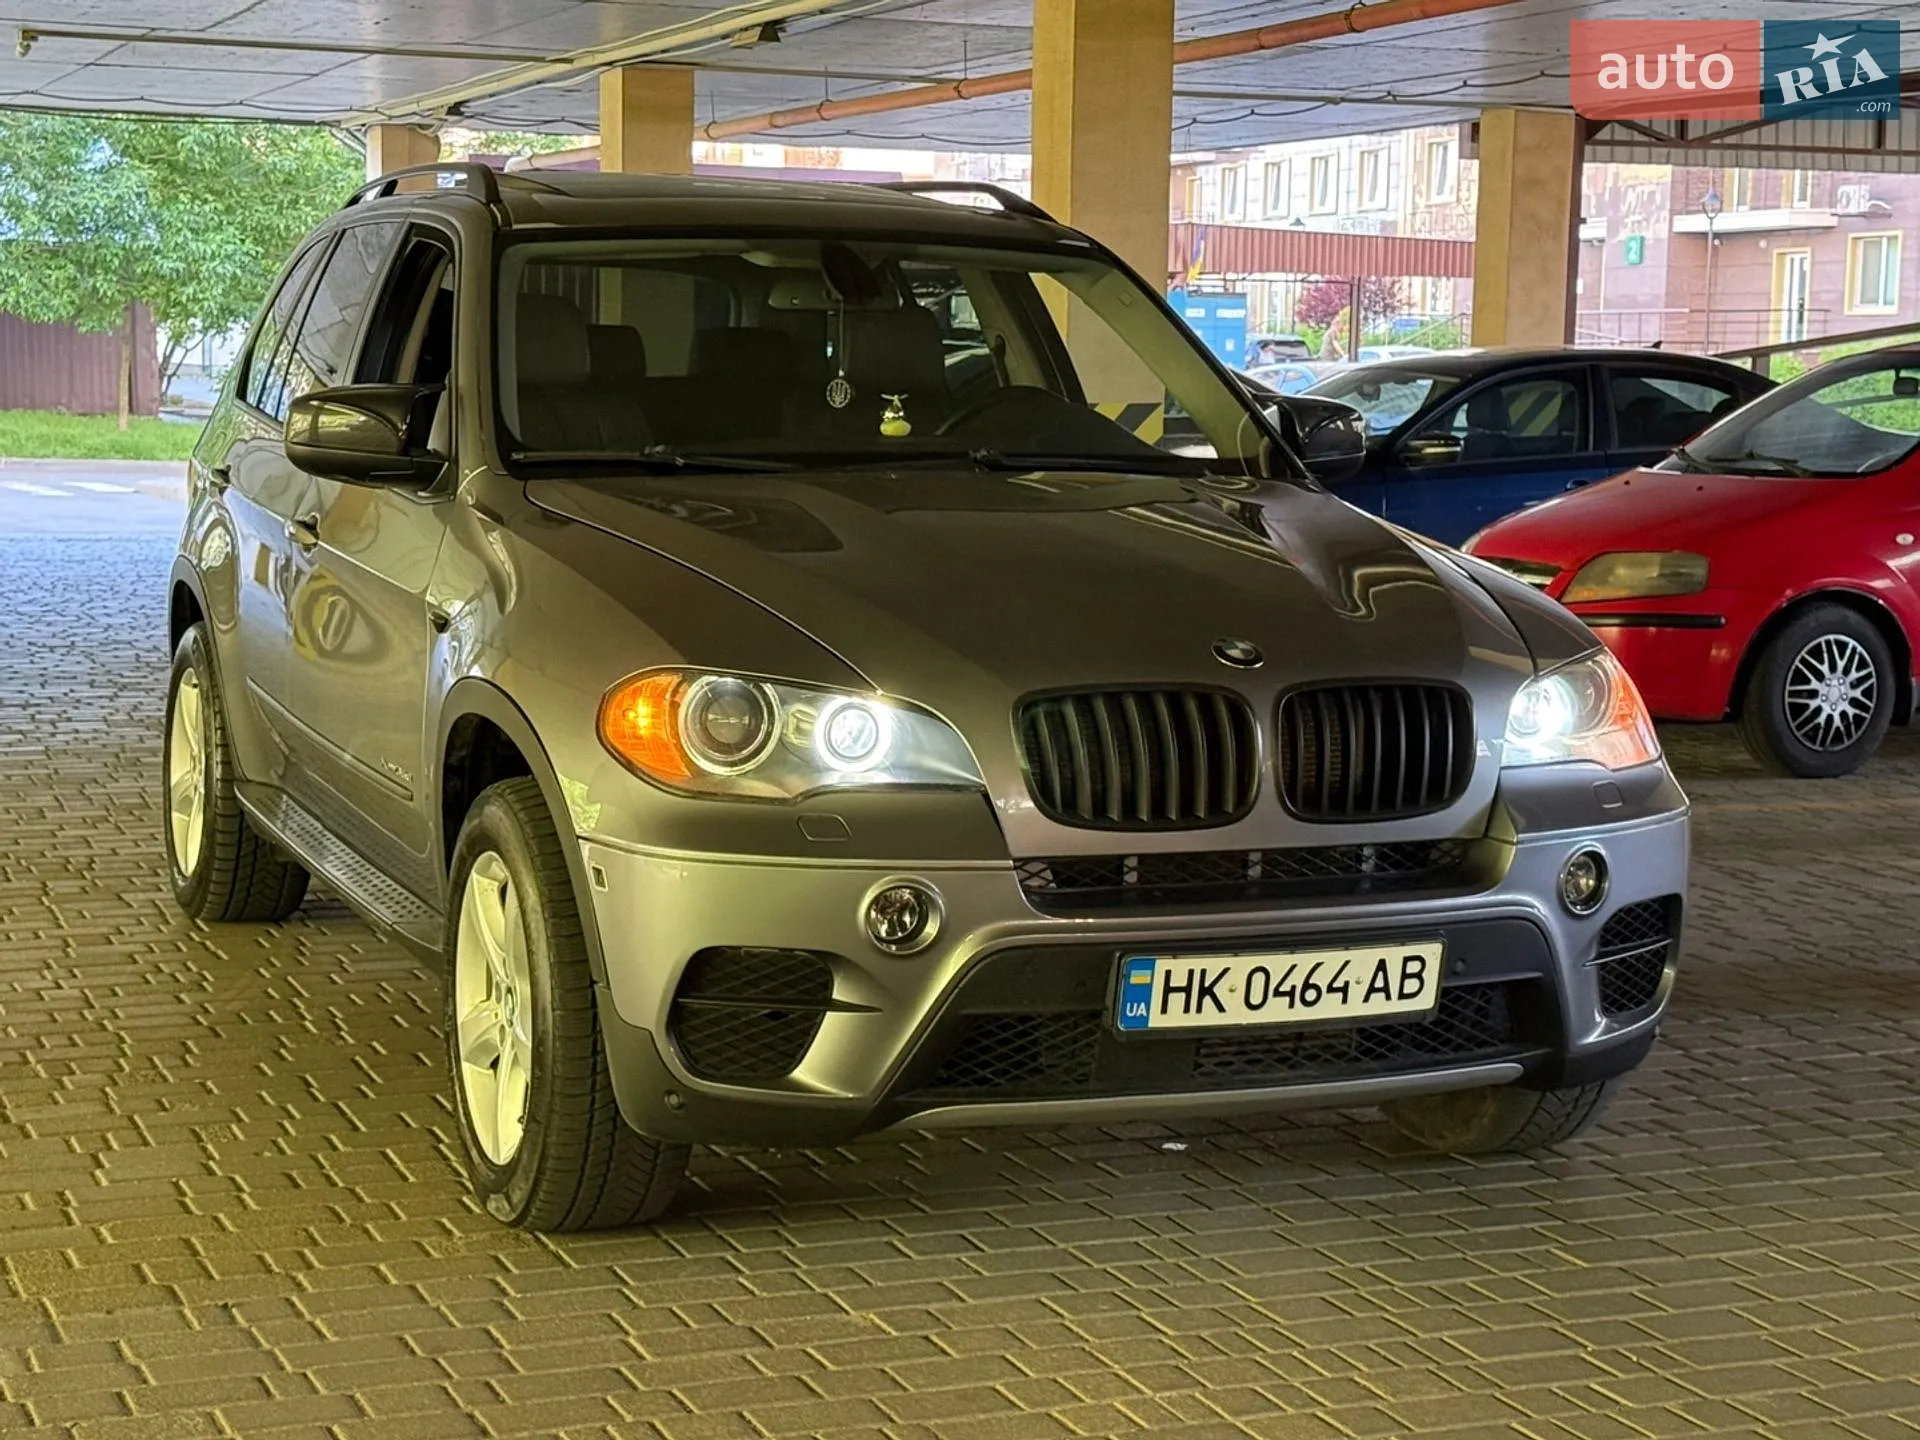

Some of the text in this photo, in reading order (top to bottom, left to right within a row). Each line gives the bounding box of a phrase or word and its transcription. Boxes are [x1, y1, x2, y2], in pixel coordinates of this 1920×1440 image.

[1160, 955, 1427, 1015] HK 0464 AB
[1126, 1002, 1147, 1017] UA
